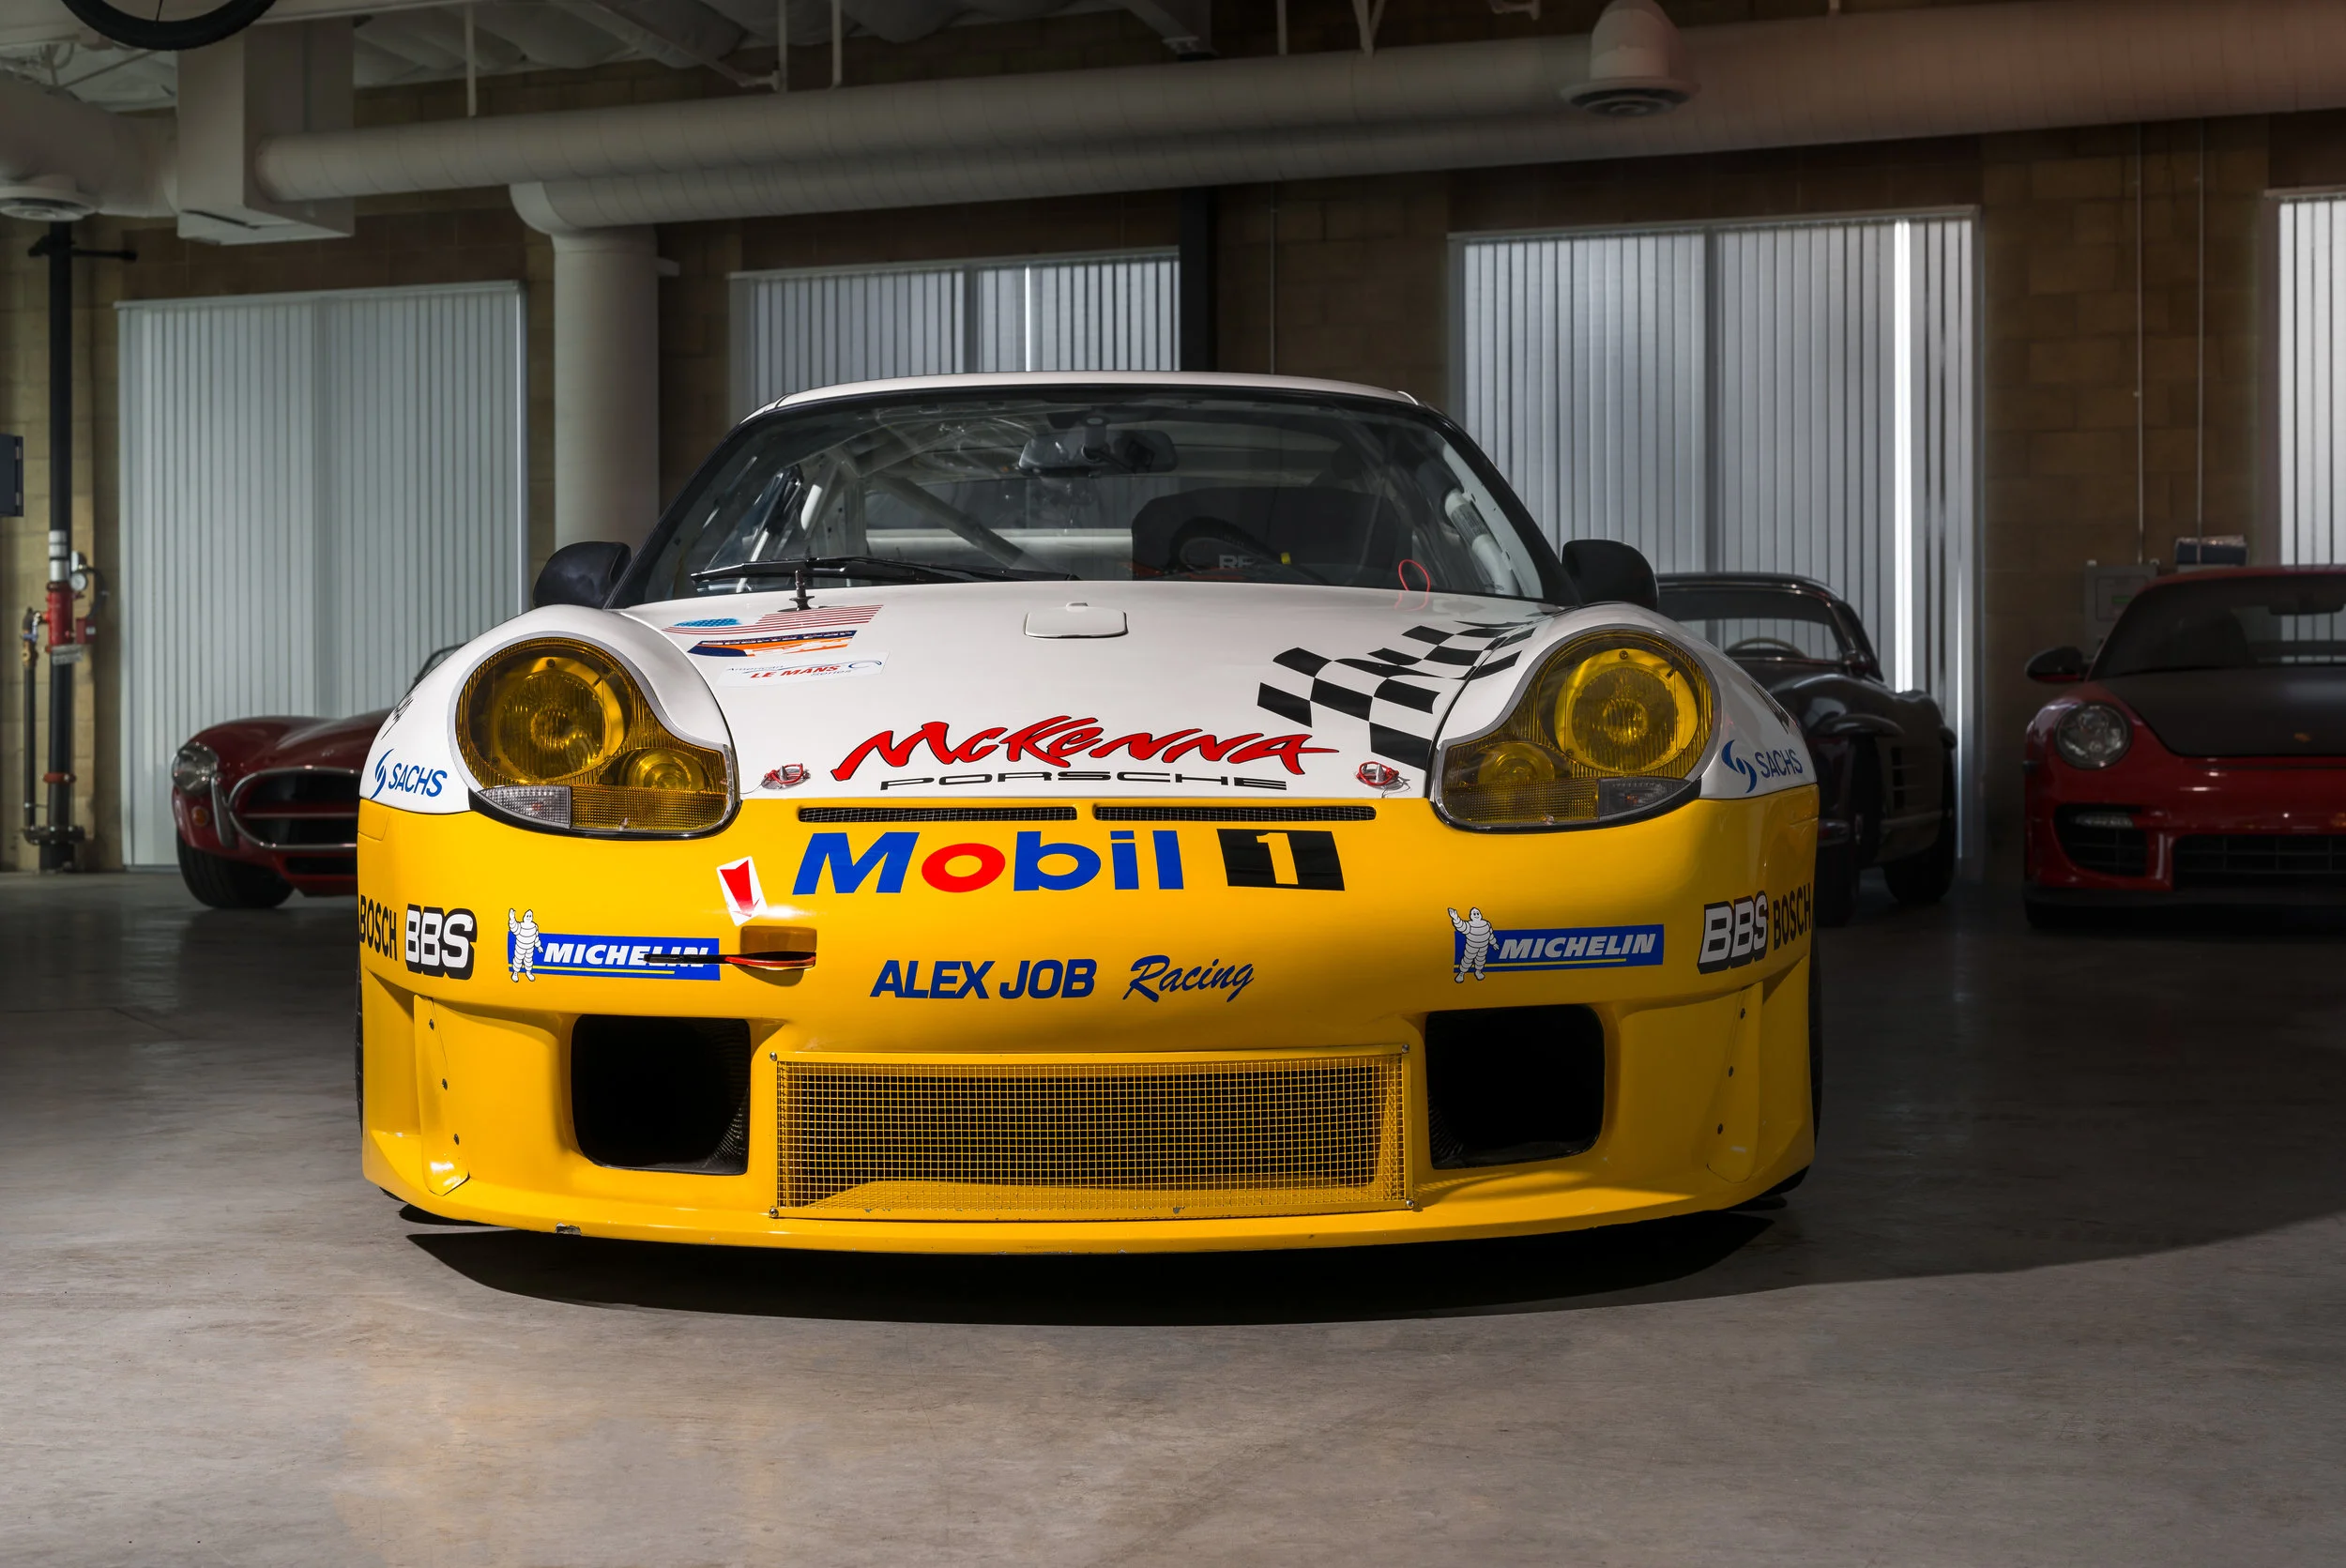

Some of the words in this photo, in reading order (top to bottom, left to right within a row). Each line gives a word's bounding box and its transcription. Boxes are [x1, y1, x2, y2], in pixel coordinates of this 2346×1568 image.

[780, 661, 841, 677] MANS
[388, 763, 448, 797] SACHS
[880, 771, 1287, 790] PORSCHE
[1754, 749, 1804, 778] SACHS
[792, 830, 1184, 895] Mobil
[1256, 832, 1299, 885] 1
[359, 894, 398, 961] BOSCH
[1698, 891, 1769, 970] BBS
[1773, 882, 1811, 951] BOSCH
[405, 906, 477, 977] BBS
[1499, 933, 1656, 960] MICHELIN
[870, 959, 995, 998] ALEX
[998, 958, 1097, 998] JOB
[1122, 954, 1255, 1002] Racing
